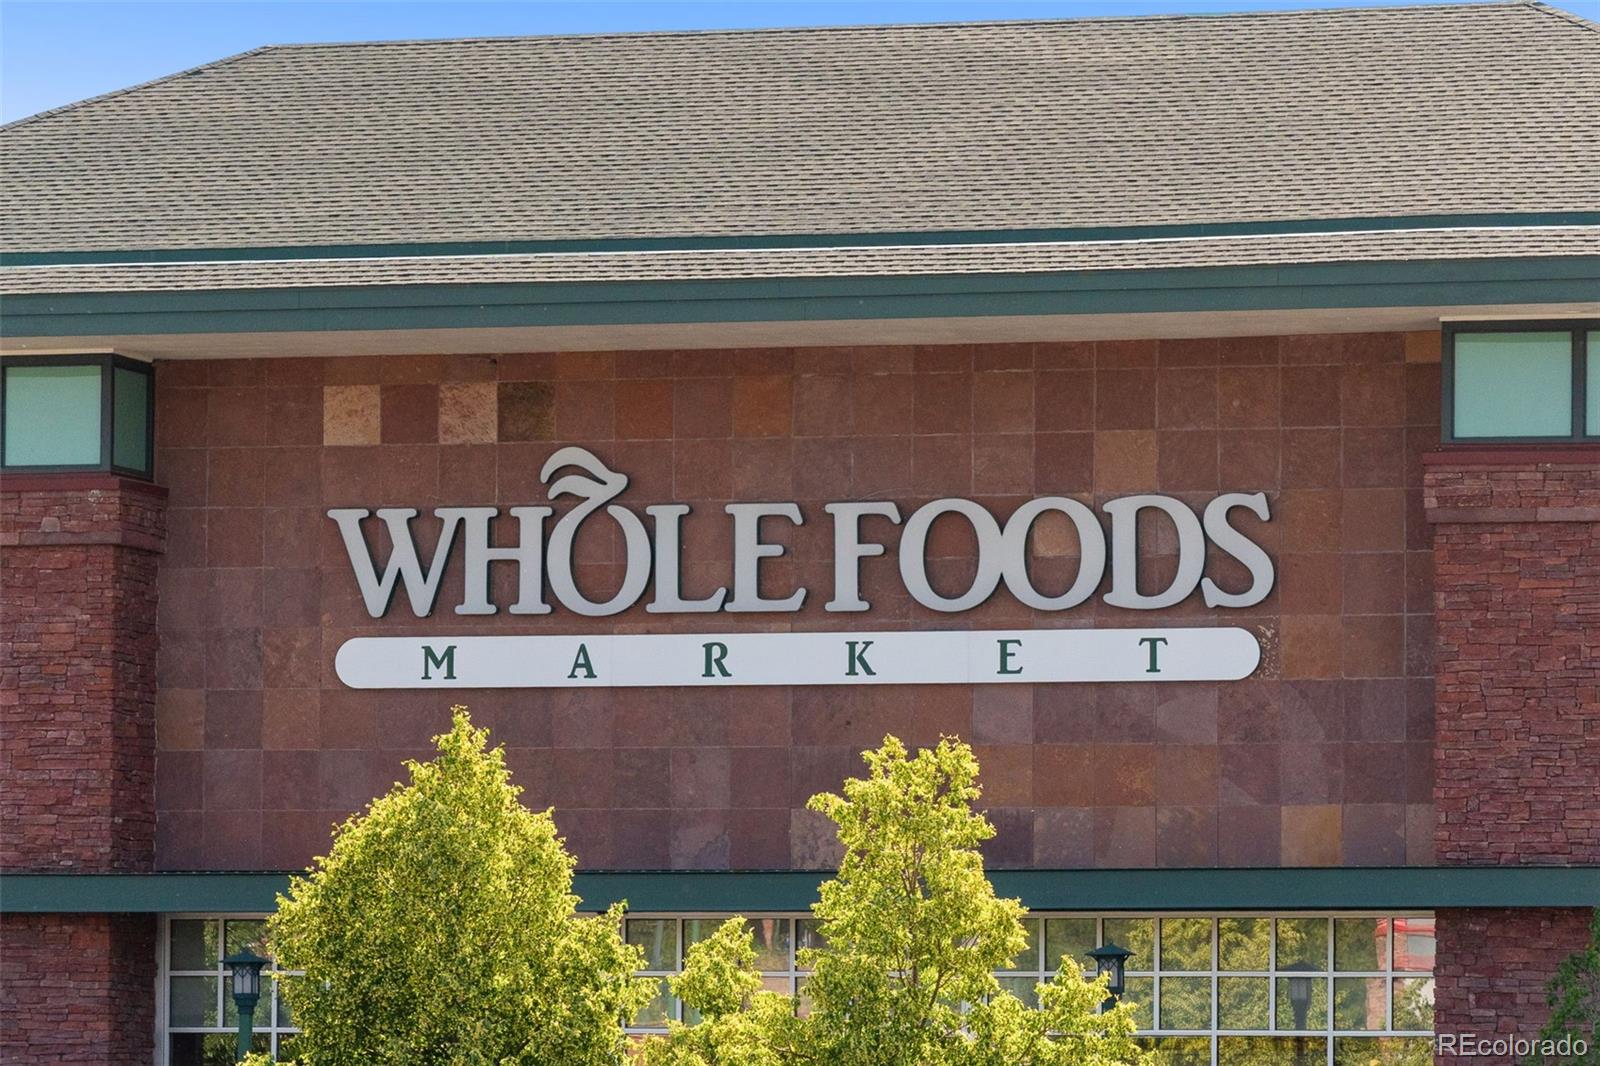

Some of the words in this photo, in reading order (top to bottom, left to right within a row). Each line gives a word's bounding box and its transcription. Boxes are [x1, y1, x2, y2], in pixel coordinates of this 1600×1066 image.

[327, 446, 807, 619] WHOLE
[824, 492, 1276, 613] FOODS
[421, 637, 1169, 680] MARKET
